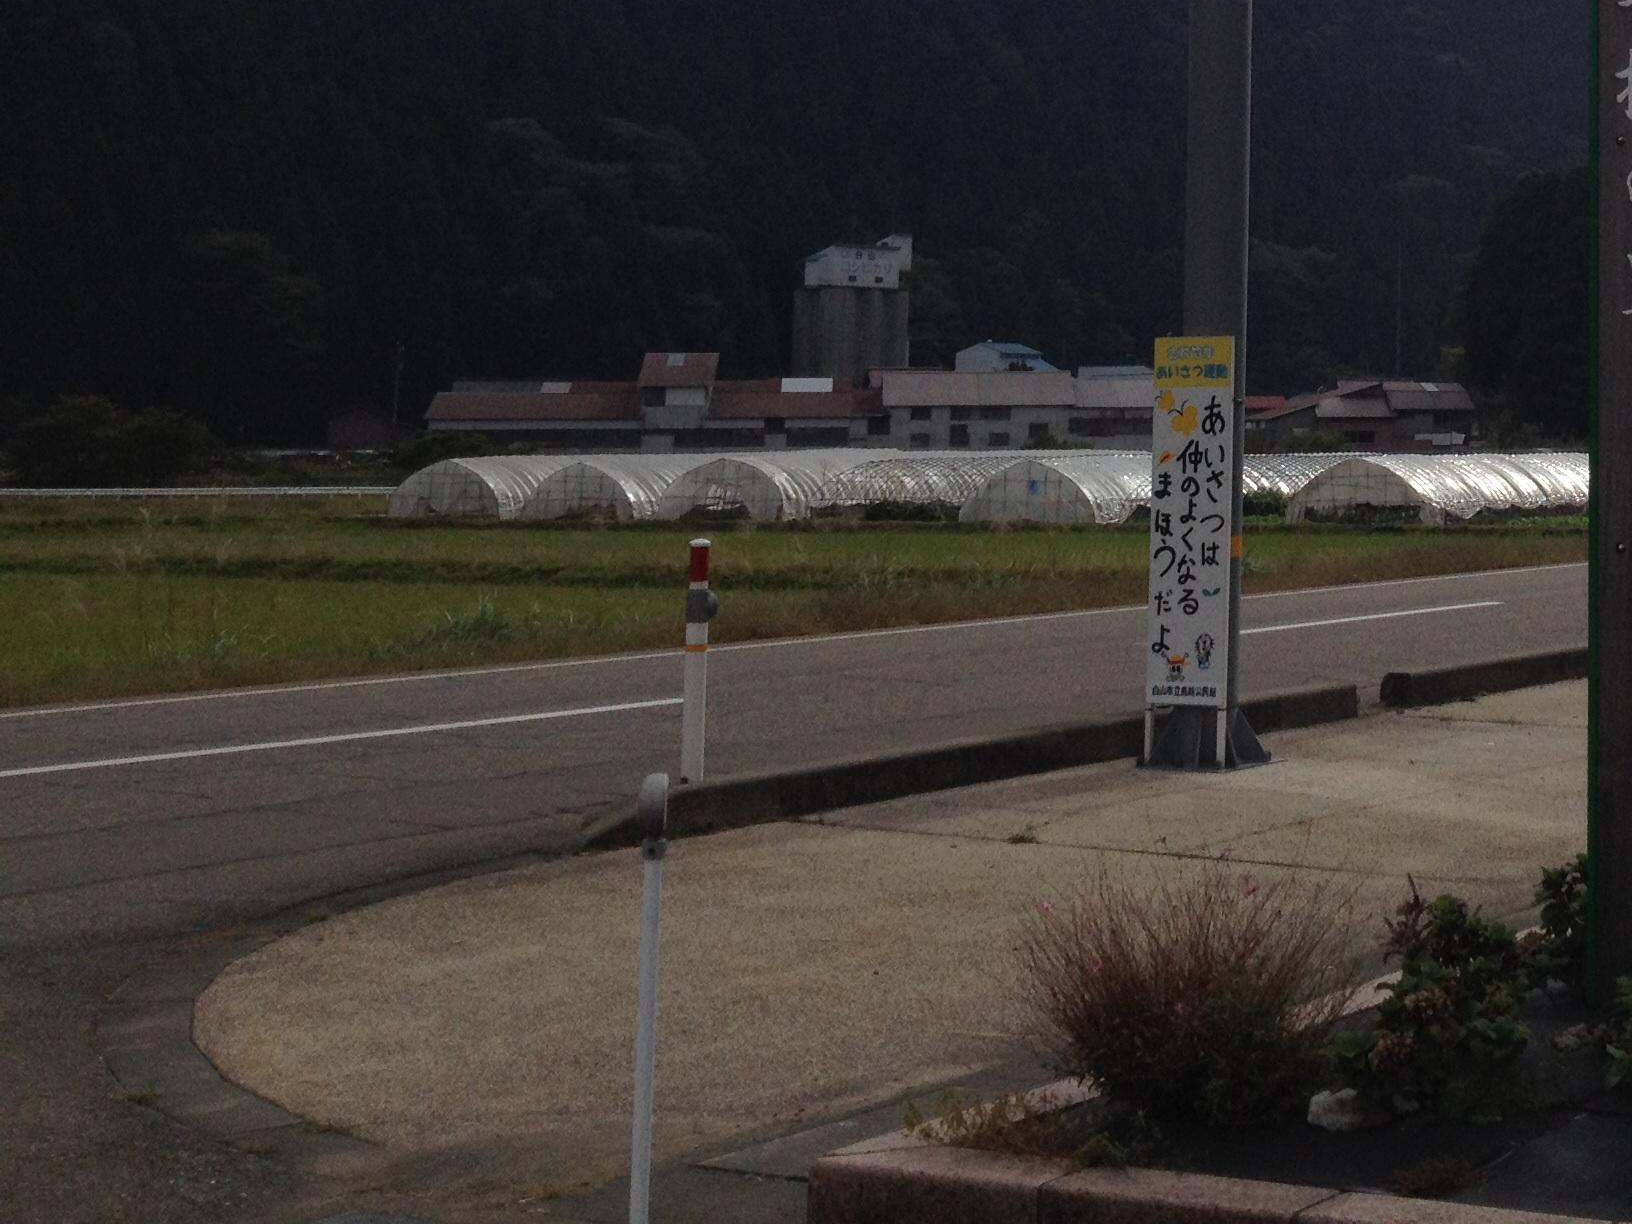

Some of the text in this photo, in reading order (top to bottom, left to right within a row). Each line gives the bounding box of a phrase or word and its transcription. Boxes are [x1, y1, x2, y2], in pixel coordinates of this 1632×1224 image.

[1151, 471, 1177, 654] まほうだよ
[1176, 440, 1204, 616] 仲のよくなる
[1199, 394, 1225, 566] あいさつは
